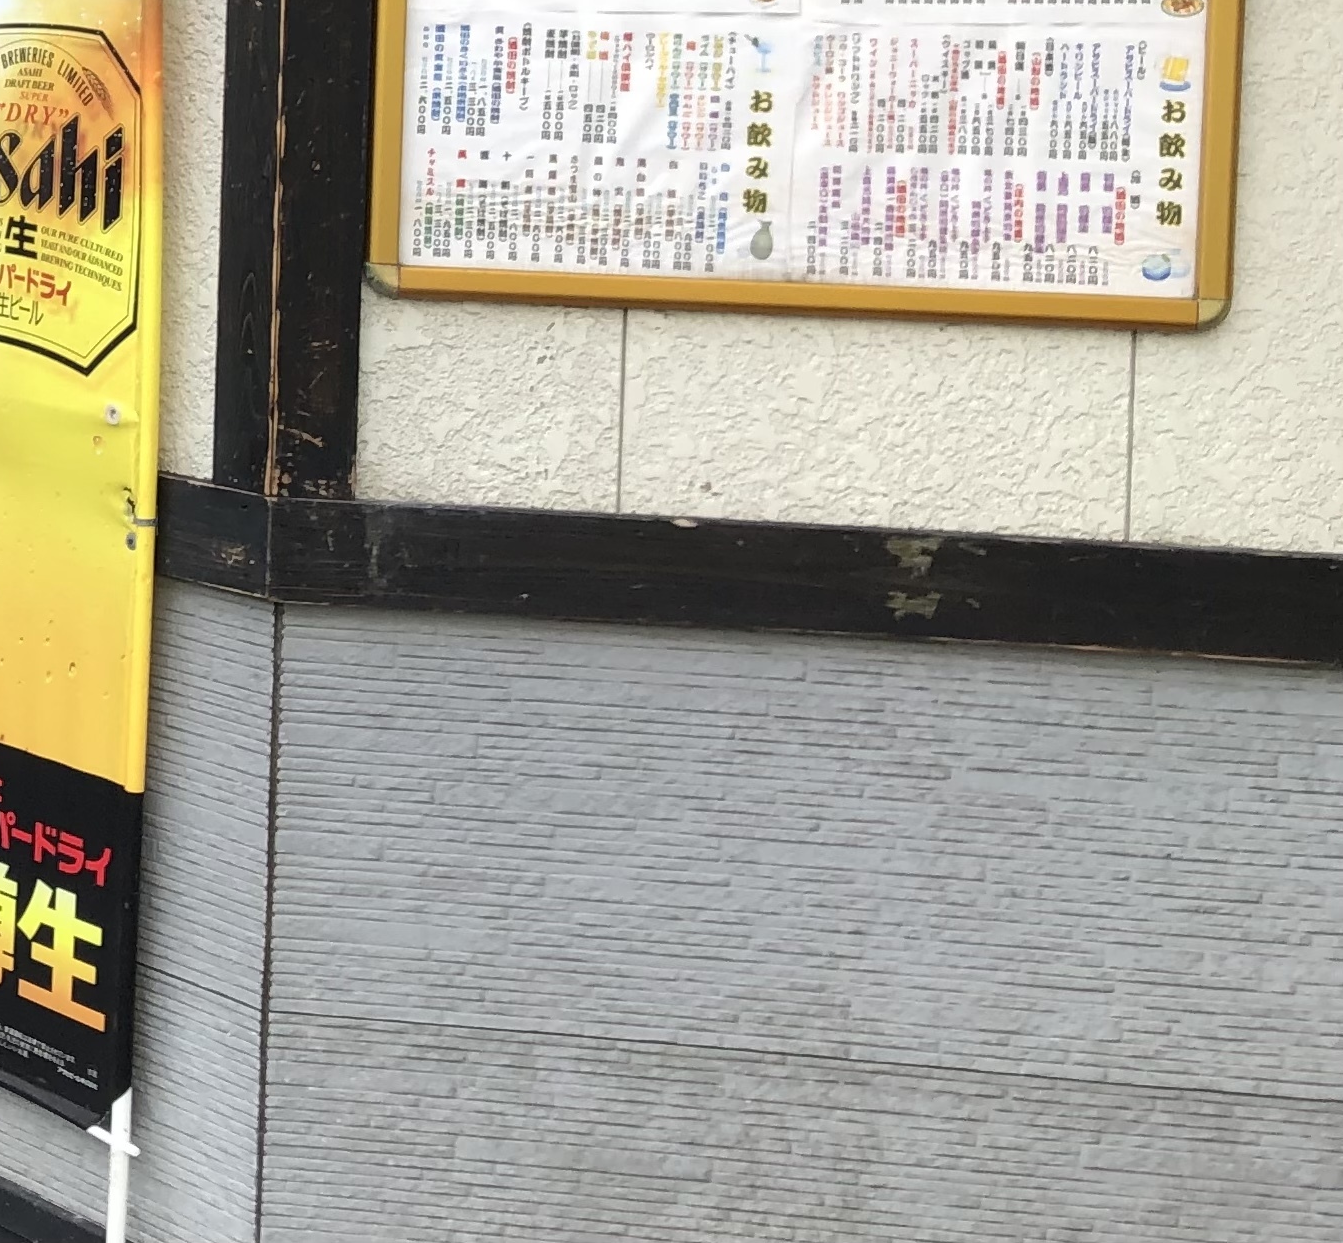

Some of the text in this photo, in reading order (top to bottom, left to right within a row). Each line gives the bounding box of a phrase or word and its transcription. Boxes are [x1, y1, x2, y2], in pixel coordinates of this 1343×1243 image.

[1, 46, 55, 69] BREWERIES
[57, 59, 94, 106] LIMITED
[5, 79, 55, 91] DRAFT BEER
[17, 68, 43, 77] ASAHI
[19, 91, 48, 102] SUPER
[742, 90, 774, 213] お飲み物
[1156, 98, 1188, 226] お飲み物
[5, 215, 38, 260] 生
[41, 226, 124, 263] OUR PURE CULTURED
[40, 240, 58, 252] YEAST
[87, 252, 123, 277] ADVANCED
[40, 253, 123, 292] BREWING TECHNIQUES
